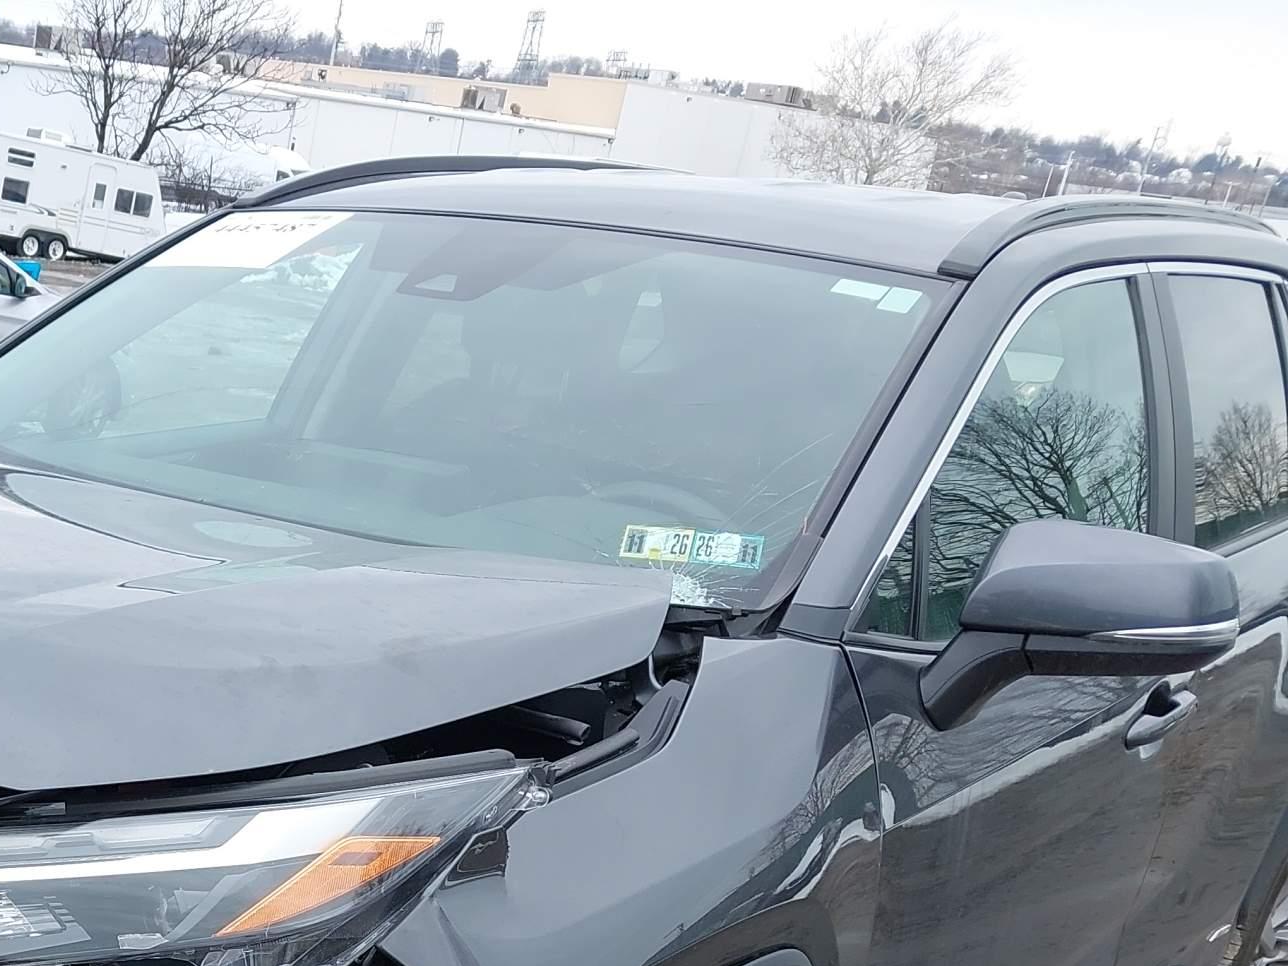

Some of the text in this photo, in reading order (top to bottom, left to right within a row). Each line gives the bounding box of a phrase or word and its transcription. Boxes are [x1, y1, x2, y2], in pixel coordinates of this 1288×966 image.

[626, 533, 689, 555] 11 26
[695, 535, 714, 557] 26
[741, 543, 759, 563] 11
